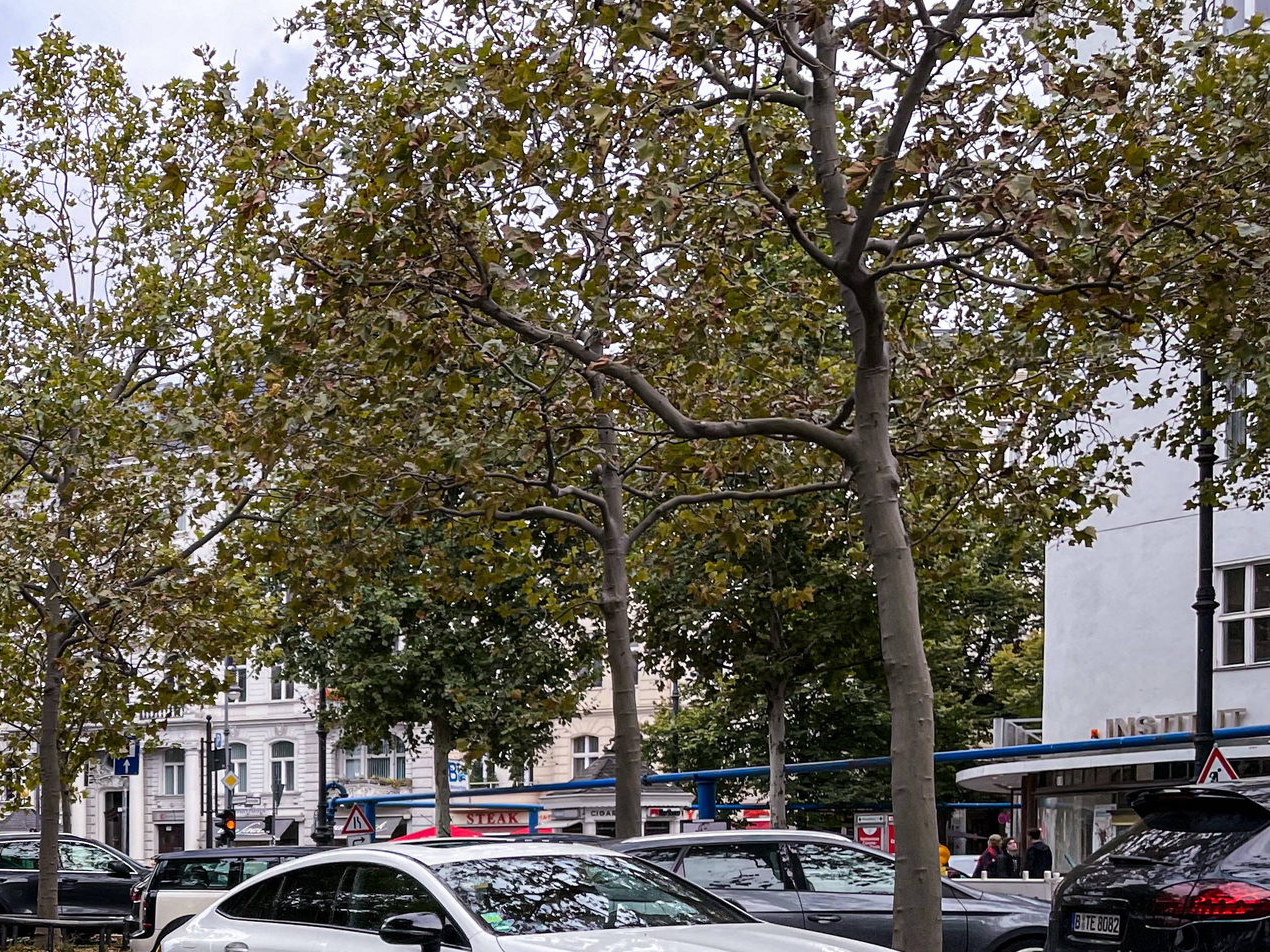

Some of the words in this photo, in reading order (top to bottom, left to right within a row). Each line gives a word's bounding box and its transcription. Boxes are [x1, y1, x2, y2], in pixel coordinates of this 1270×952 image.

[467, 812, 519, 825] STEAK
[1075, 914, 1081, 930] B
[1086, 915, 1097, 931] TE
[1097, 916, 1119, 933] 8082
